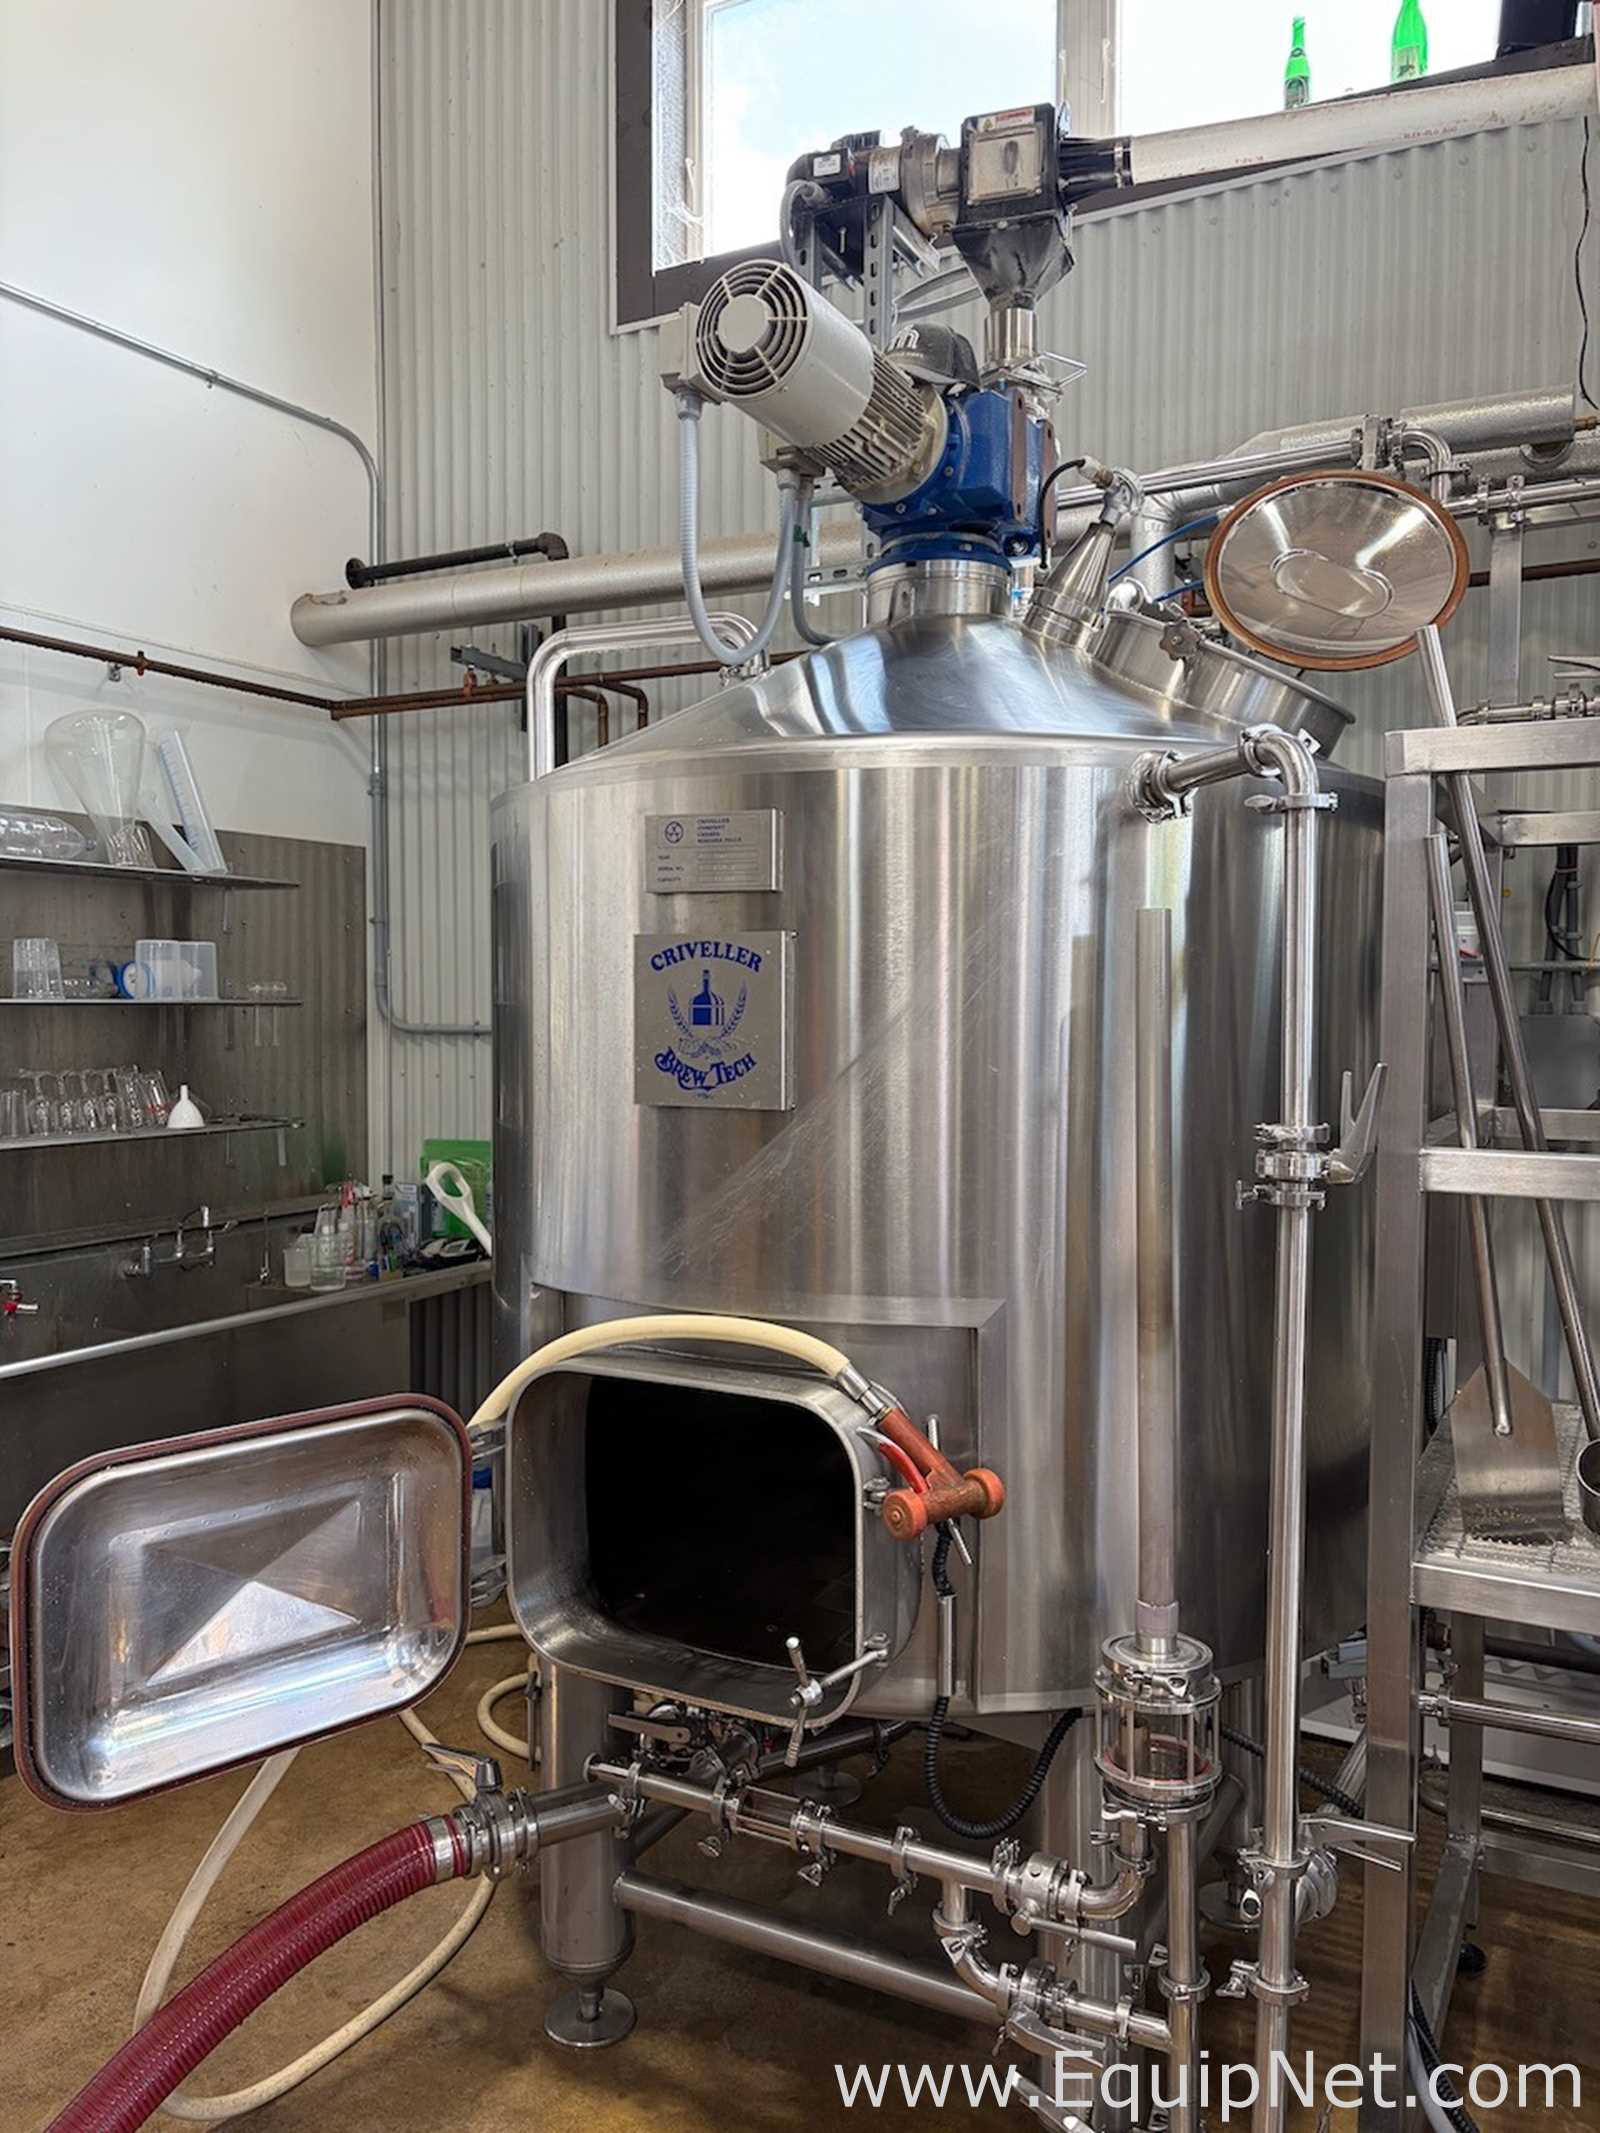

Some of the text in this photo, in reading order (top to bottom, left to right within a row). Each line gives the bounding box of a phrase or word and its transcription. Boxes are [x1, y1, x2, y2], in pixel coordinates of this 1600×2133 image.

[650, 940, 763, 973] CRIVELLER
[654, 1046, 757, 1091] BREW TECH
